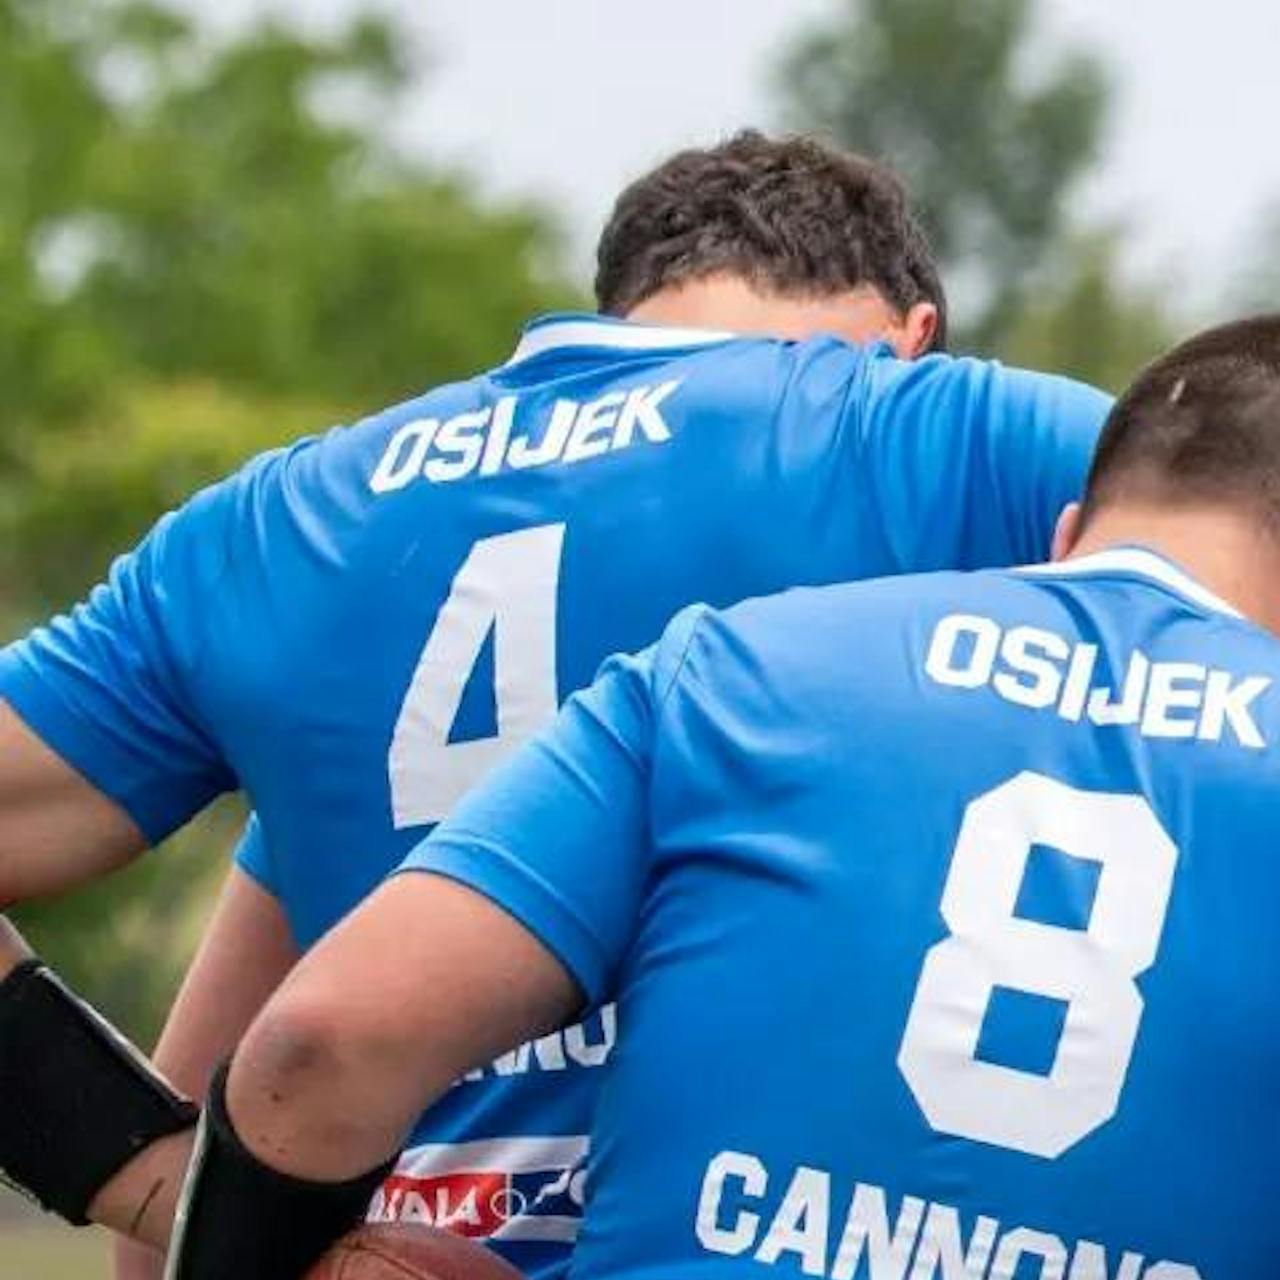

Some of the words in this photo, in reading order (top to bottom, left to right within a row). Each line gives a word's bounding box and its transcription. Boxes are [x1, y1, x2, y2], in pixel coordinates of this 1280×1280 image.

[369, 380, 683, 494] OSIJEK
[388, 523, 566, 830] 4
[925, 613, 1271, 749] OSIJEK
[897, 769, 1179, 1160] 8
